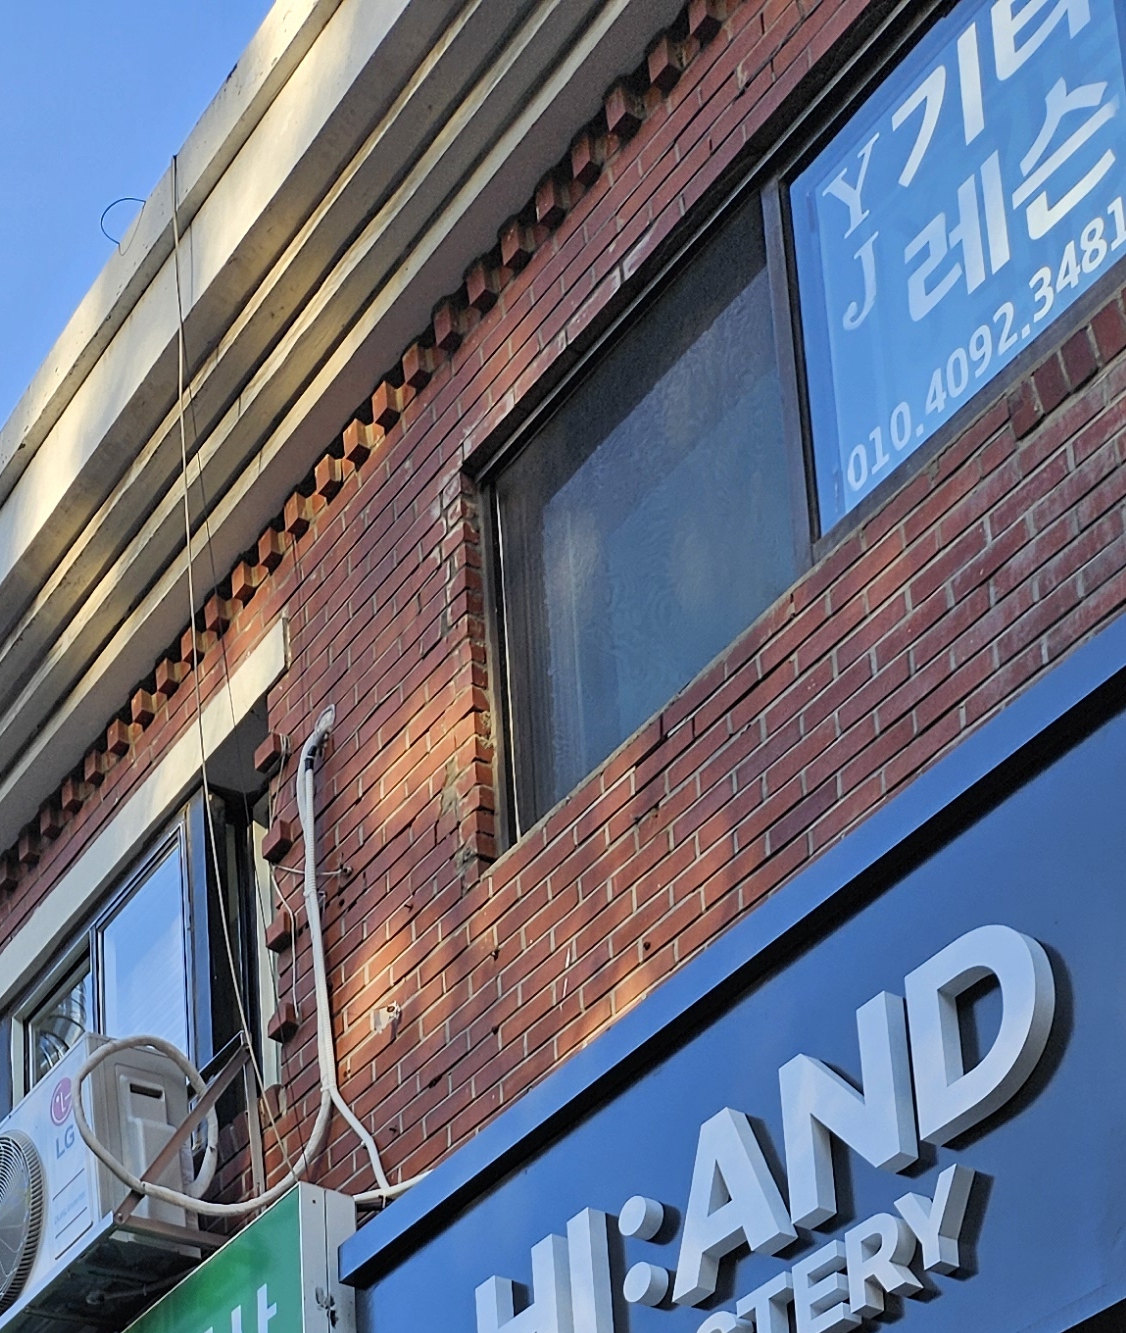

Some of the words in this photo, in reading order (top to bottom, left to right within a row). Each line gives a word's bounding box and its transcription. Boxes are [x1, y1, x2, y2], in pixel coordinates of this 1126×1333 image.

[904, 77, 1119, 322] 레슨
[846, 195, 1126, 491] 010.4092.3481
[55, 1124, 75, 1160] LG
